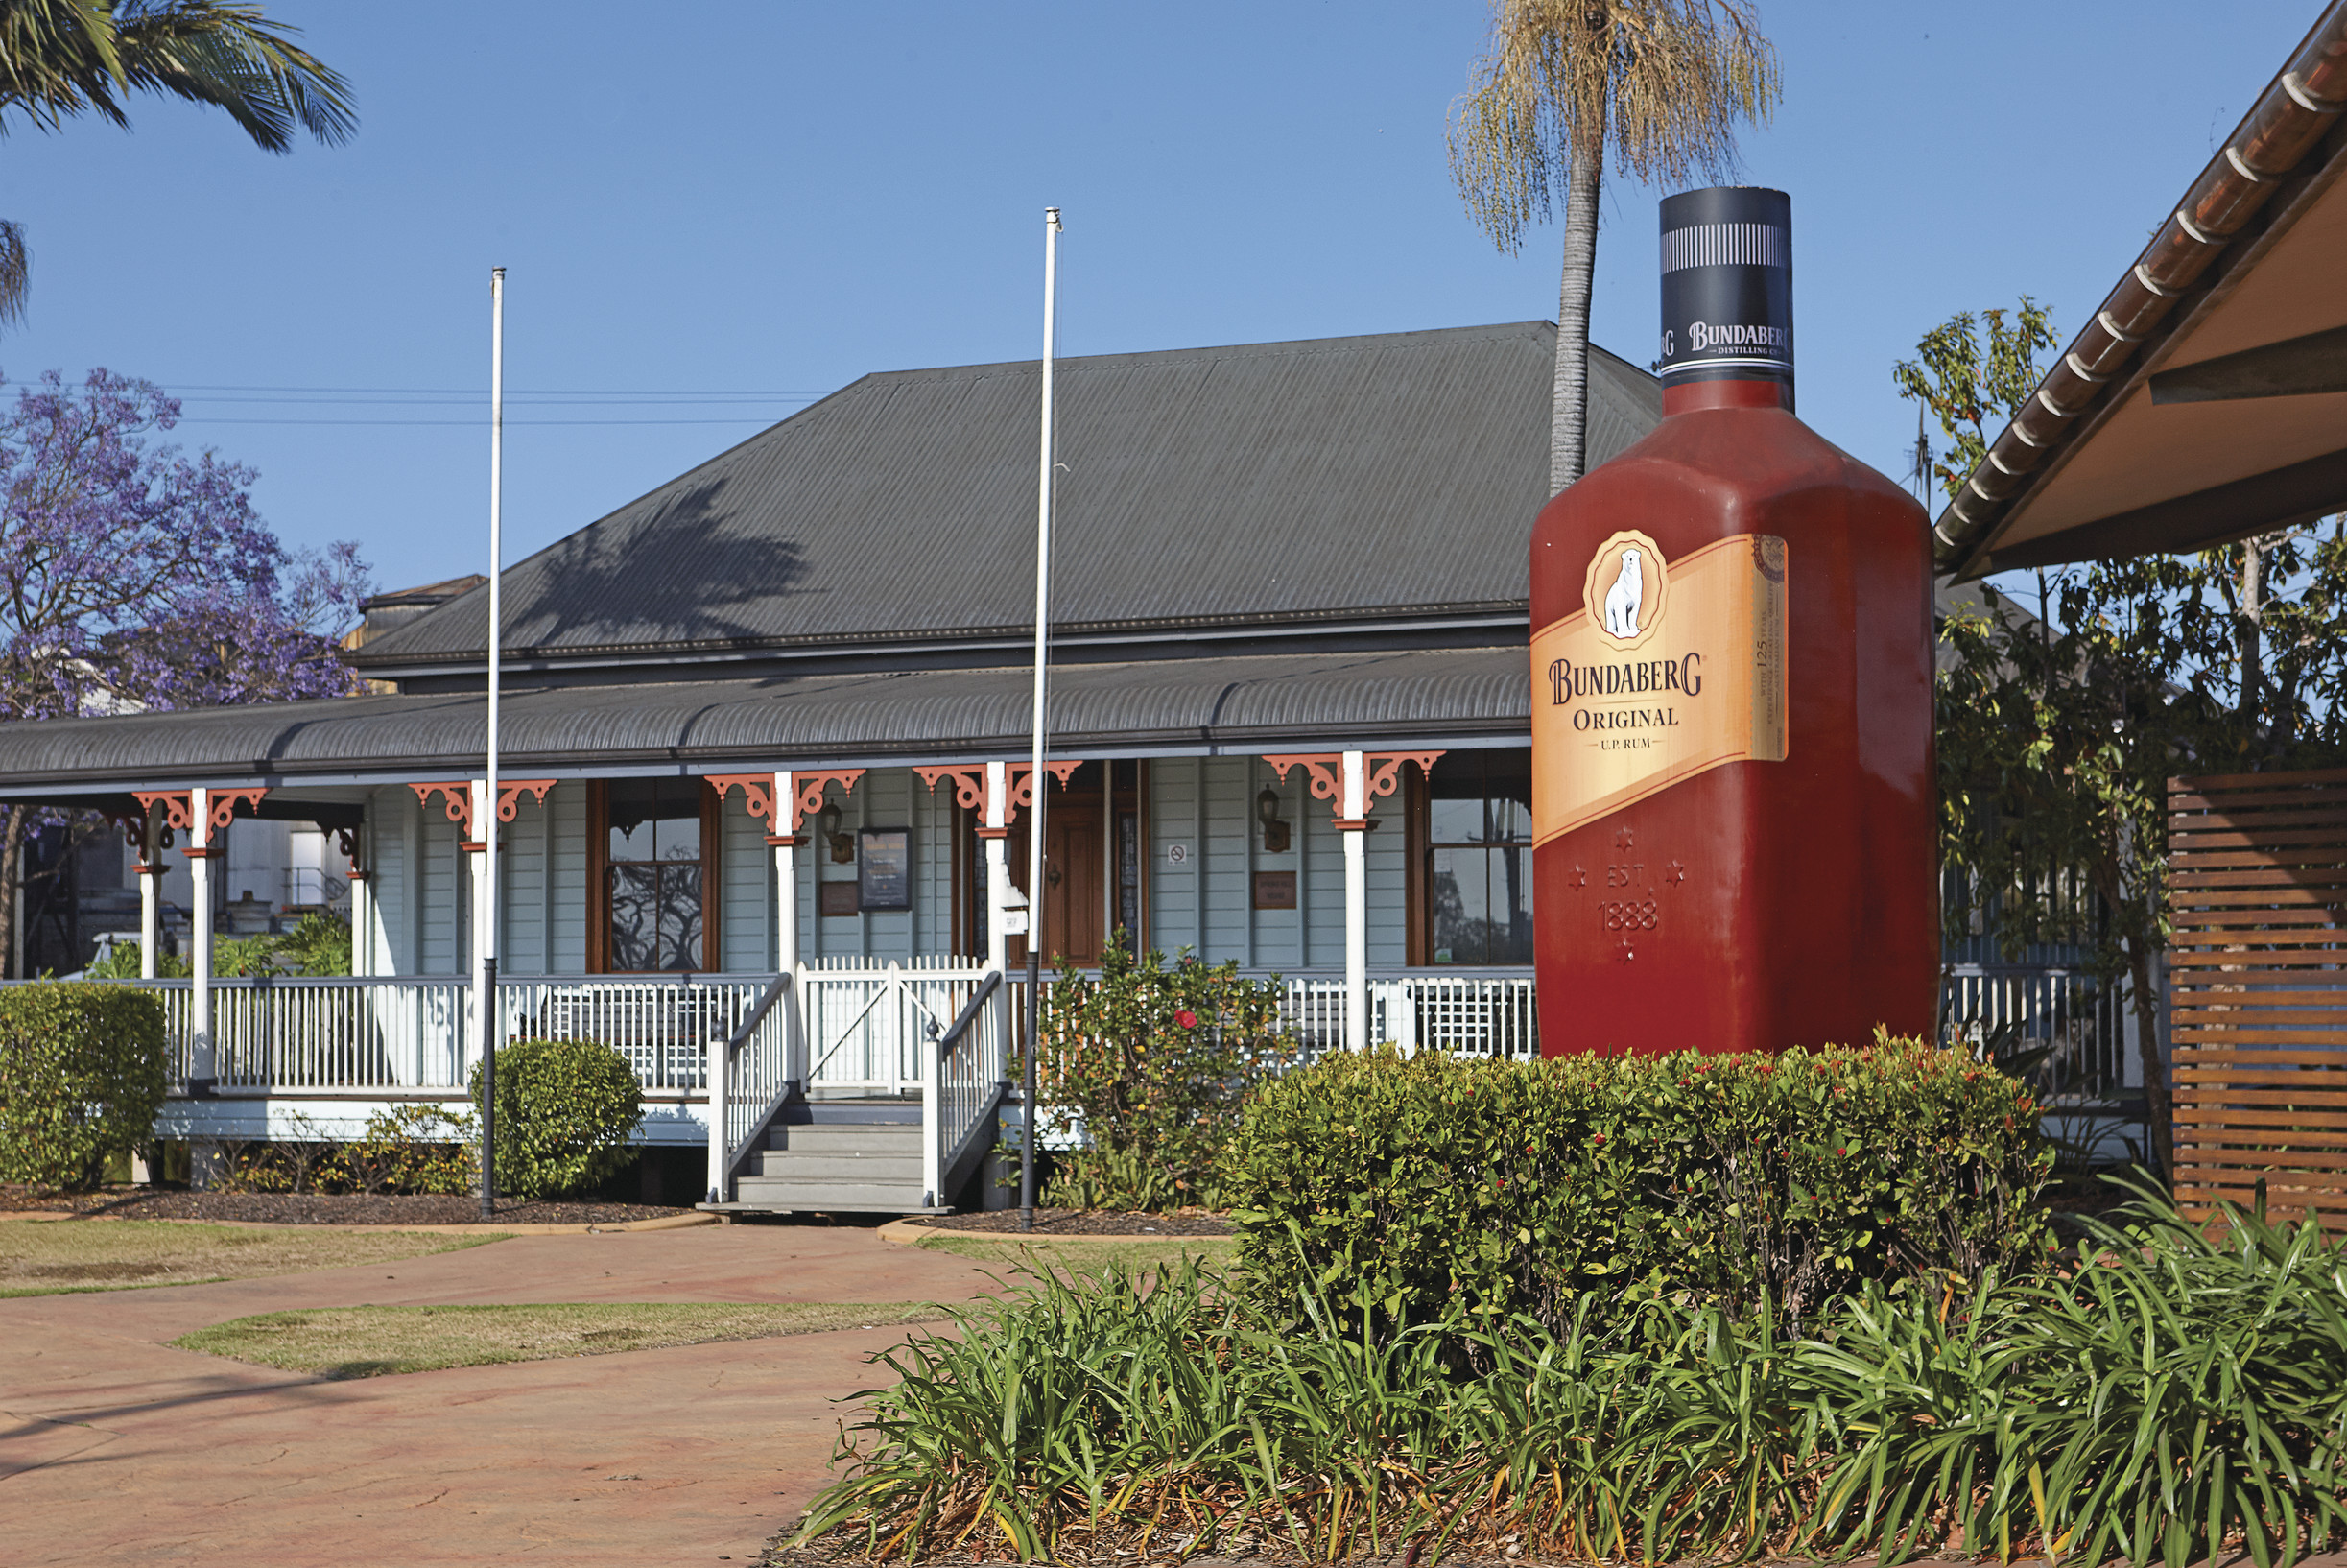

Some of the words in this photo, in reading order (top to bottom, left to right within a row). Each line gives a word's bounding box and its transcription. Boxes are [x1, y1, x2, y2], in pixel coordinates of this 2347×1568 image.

[1689, 321, 1790, 352] BUNDABERG
[1718, 346, 1768, 355] DISTILLING
[1757, 640, 1767, 669] 125
[1549, 653, 1701, 705] BUNDABERG
[1573, 707, 1679, 731] ORIGINAL
[1601, 739, 1621, 750] U.P.
[1624, 737, 1651, 749] RUM
[1597, 899, 1659, 932] 1888
